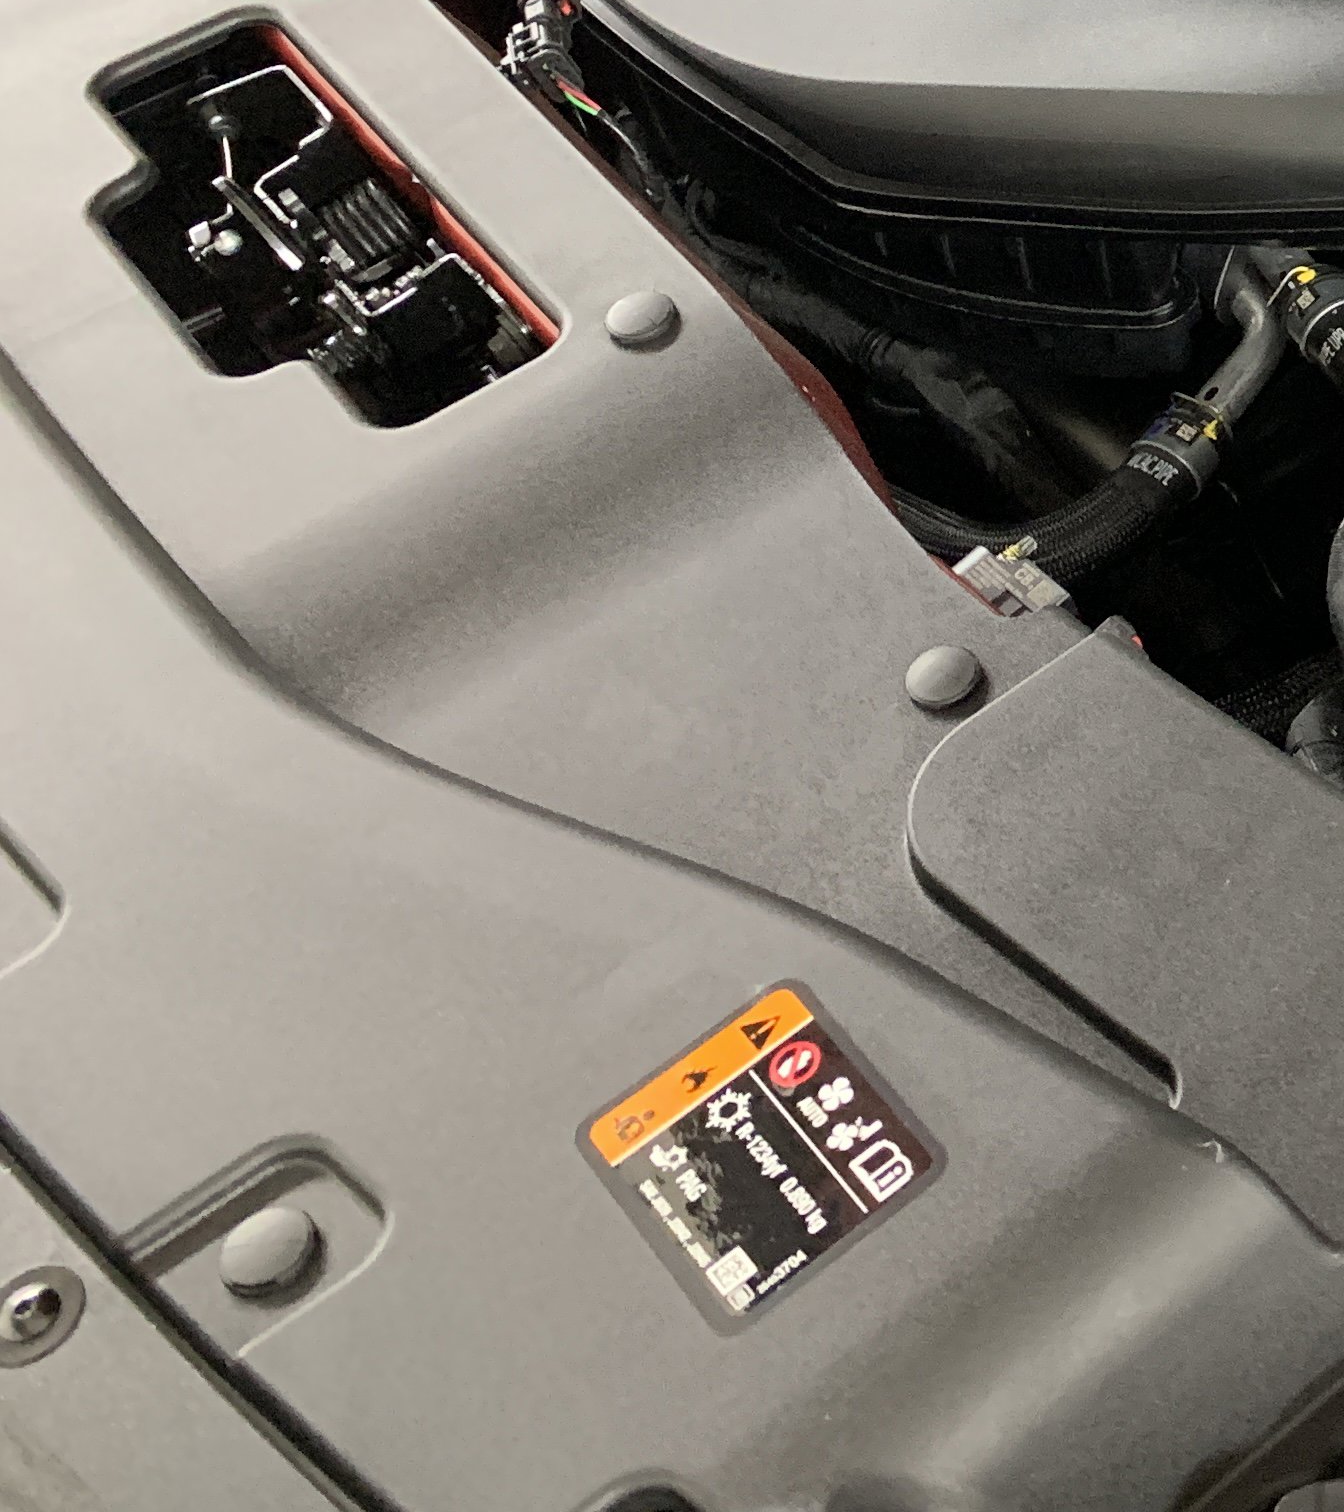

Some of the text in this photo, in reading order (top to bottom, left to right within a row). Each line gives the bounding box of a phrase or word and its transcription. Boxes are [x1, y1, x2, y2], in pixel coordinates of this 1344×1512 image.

[796, 1095, 829, 1129] AUTO
[734, 1120, 788, 1179] R-1234yf
[675, 1169, 707, 1203] PAG
